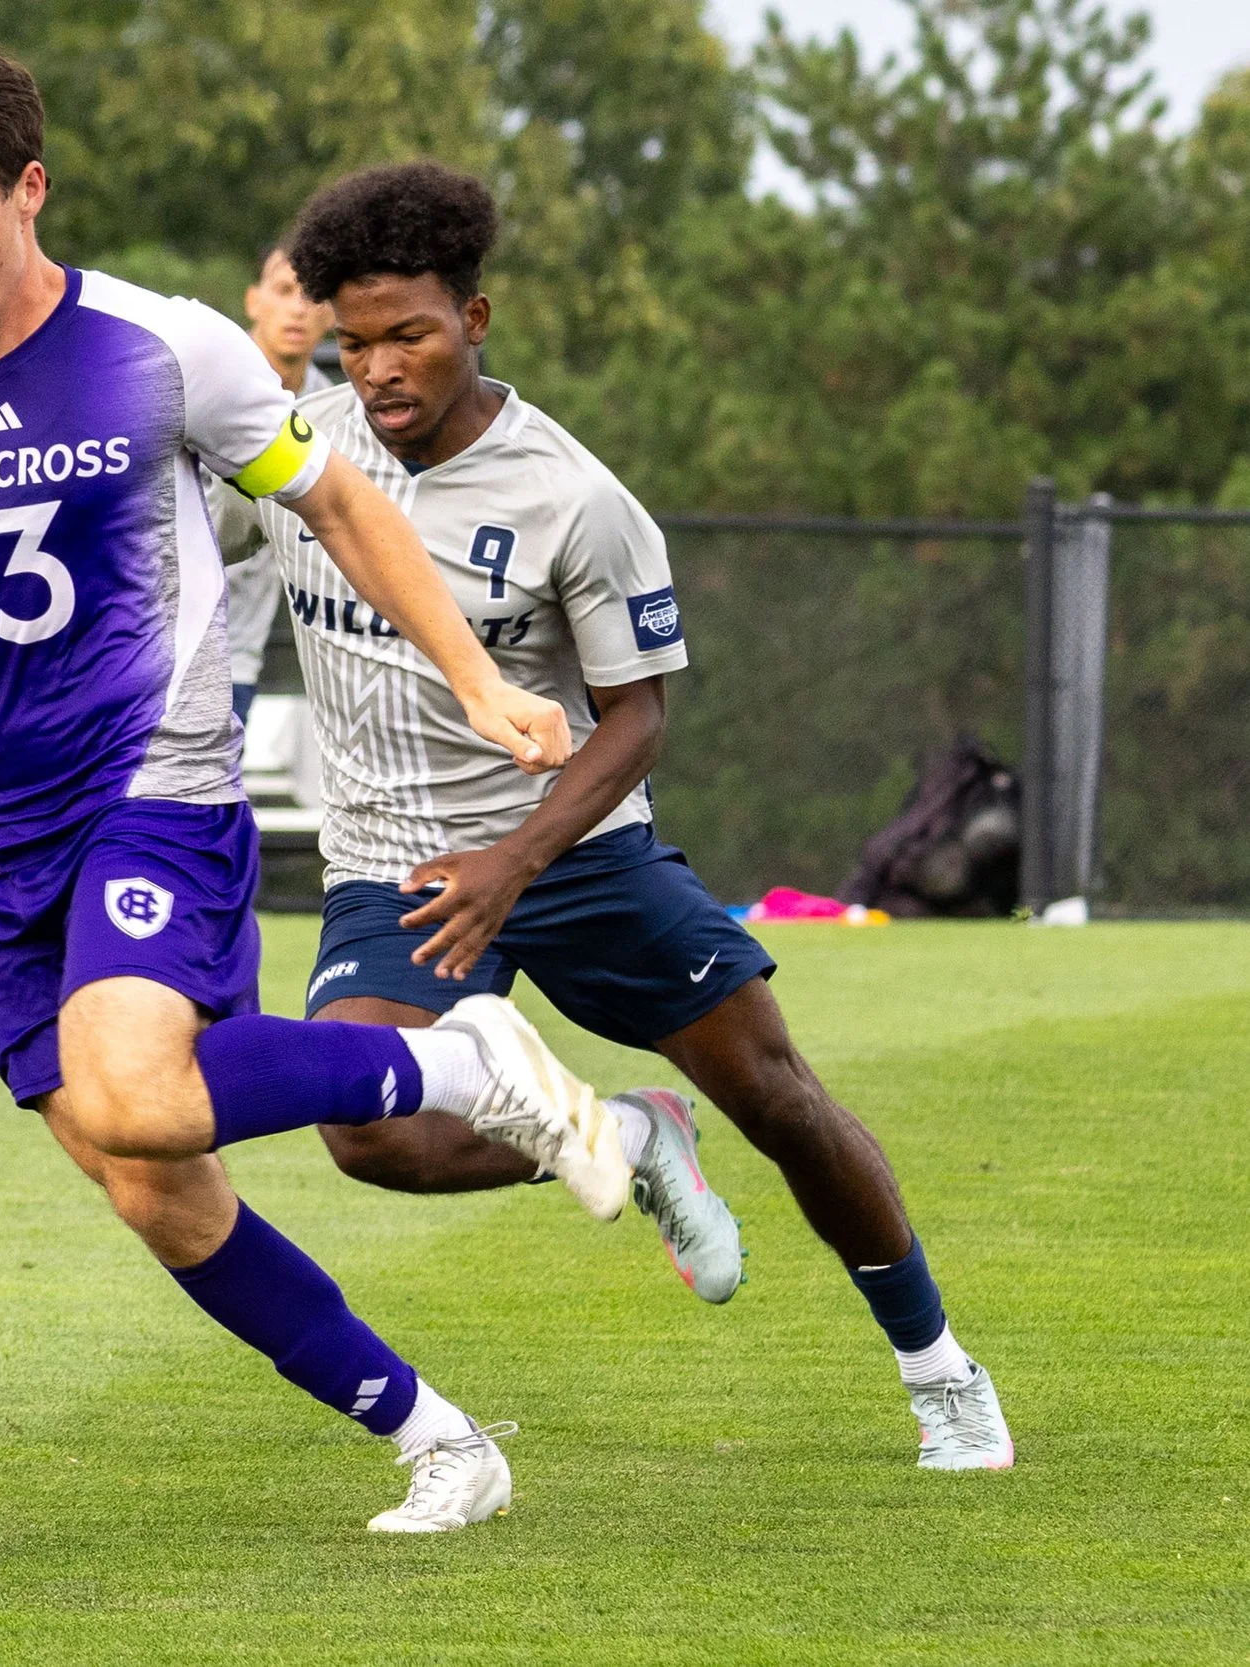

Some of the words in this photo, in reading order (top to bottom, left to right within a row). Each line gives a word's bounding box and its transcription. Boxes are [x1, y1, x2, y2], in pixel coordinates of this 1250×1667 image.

[468, 522, 519, 603] 9
[289, 582, 535, 648] WILDTS
[652, 615, 674, 628] EAST
